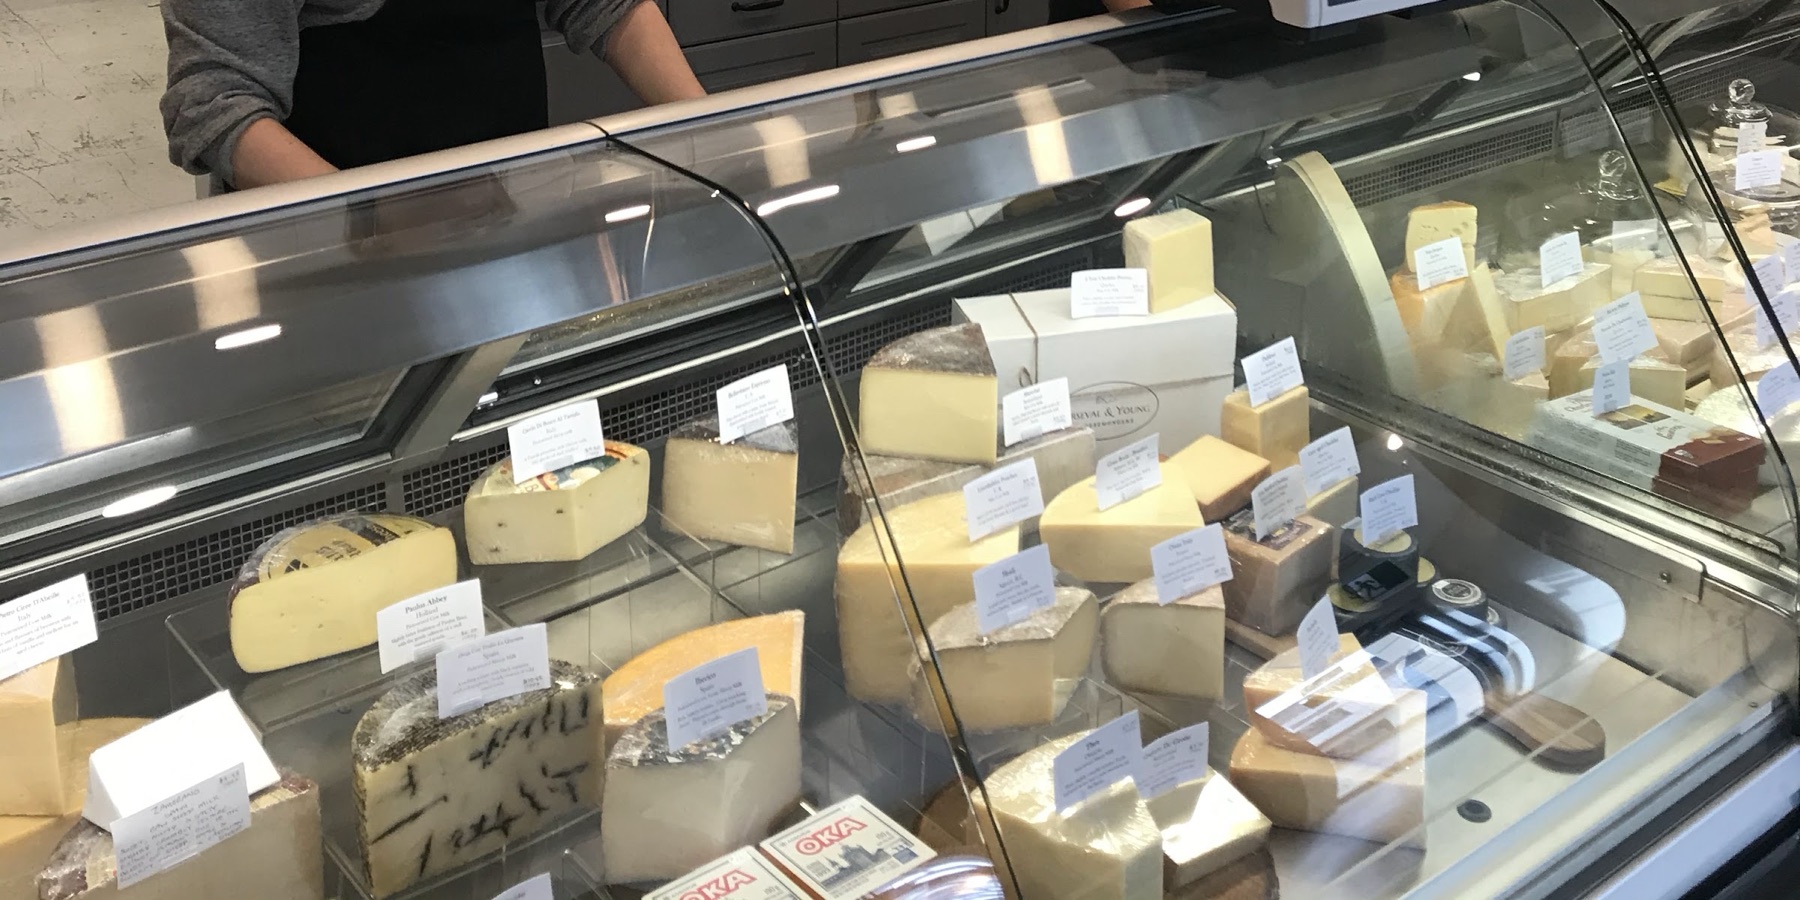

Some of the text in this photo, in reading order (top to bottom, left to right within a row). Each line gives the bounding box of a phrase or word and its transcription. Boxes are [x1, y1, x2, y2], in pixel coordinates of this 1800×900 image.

[1104, 407, 1115, 418] &
[427, 595, 448, 606] Abbey
[795, 817, 867, 855] OKA
[679, 868, 757, 900] OKA
